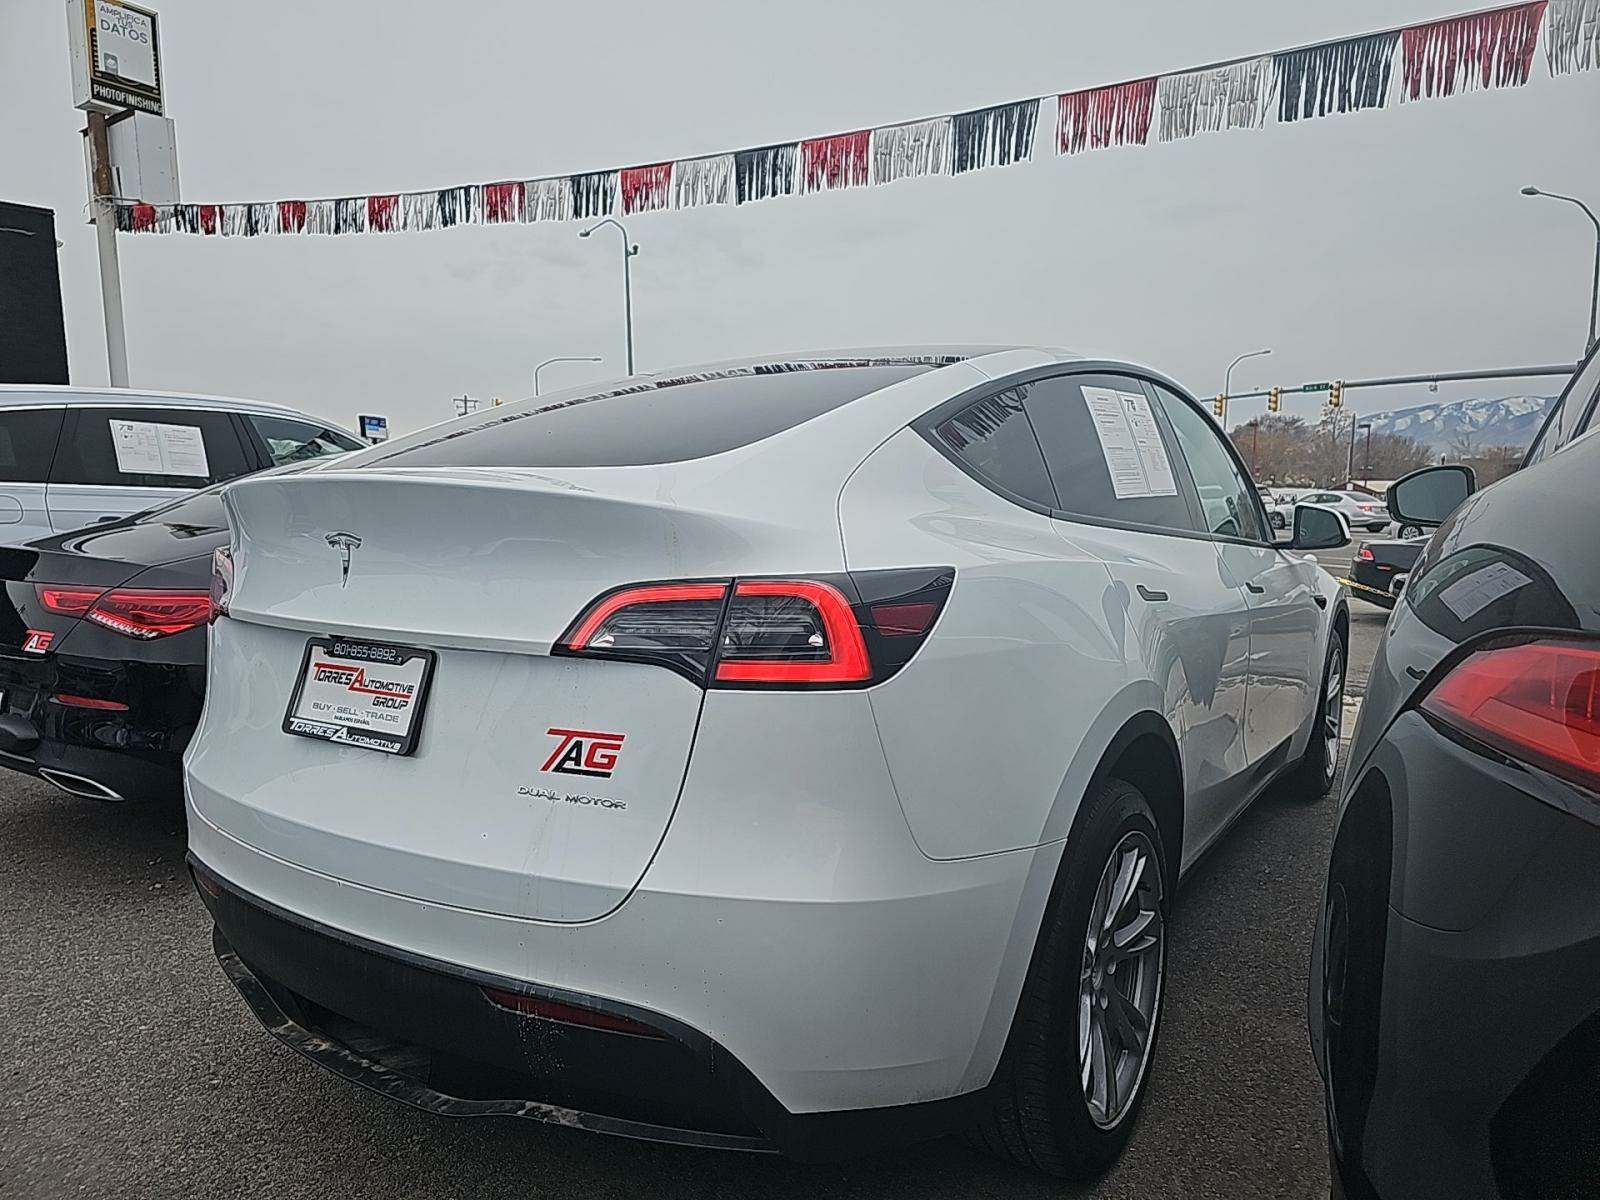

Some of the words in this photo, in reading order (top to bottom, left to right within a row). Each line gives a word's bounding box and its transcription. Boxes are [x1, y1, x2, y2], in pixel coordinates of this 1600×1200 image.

[100, 5, 147, 28] AMPLIFICA
[116, 17, 134, 29] TUS
[100, 19, 148, 44] DATOS
[93, 84, 163, 113] PHOTOFINISHING
[21, 629, 55, 655] TAG
[313, 662, 359, 686] TORRES
[348, 668, 415, 695] AUTOMOTIVE
[312, 702, 333, 712] BUY
[336, 706, 358, 716] SELL
[365, 710, 400, 723] TRADE
[372, 696, 409, 710] GROUP
[289, 717, 341, 738] TORRES
[330, 727, 402, 751] AUTOMOTIVE
[539, 728, 626, 778] TAG
[517, 786, 561, 801] DUAL
[564, 793, 627, 810] MOTOR
